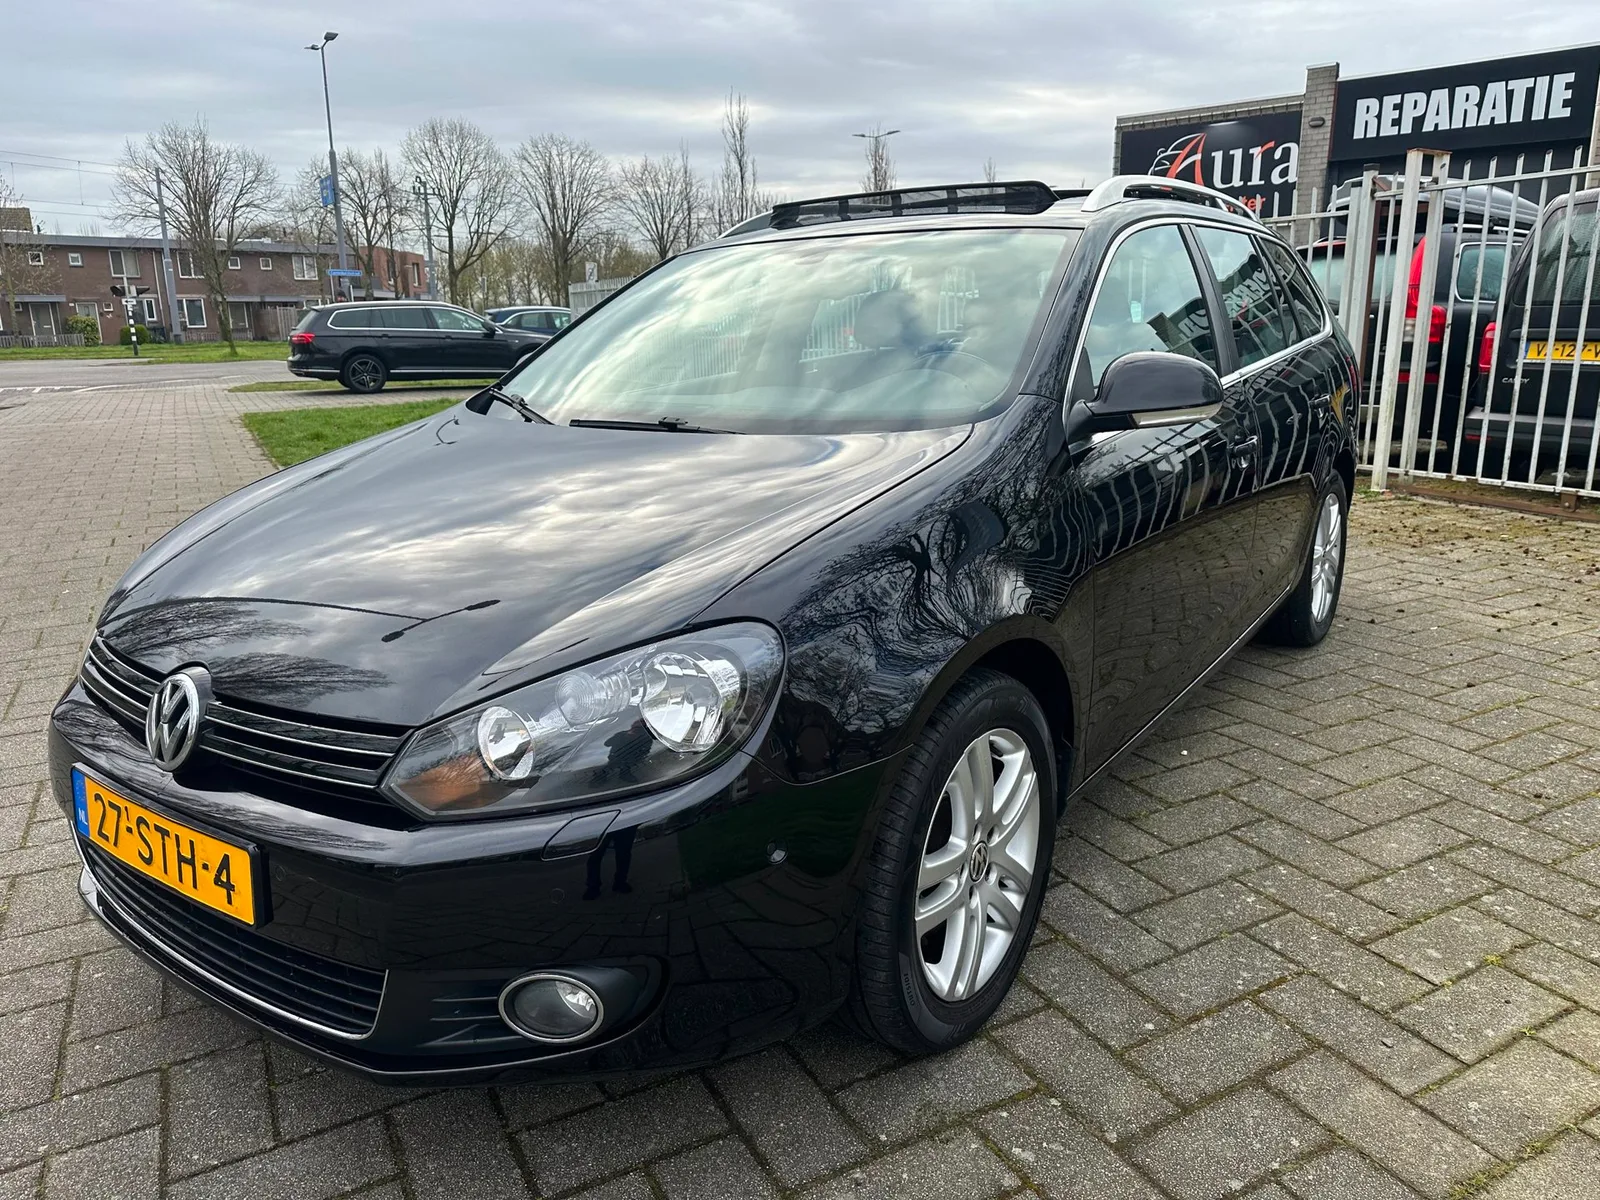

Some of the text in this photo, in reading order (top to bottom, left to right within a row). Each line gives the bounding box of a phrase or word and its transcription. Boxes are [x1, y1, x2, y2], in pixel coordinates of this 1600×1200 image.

[1353, 72, 1575, 139] REPARATIE
[1160, 132, 1299, 190] Aura
[78, 808, 88, 826] NL
[94, 792, 235, 906] 27-STH-4
